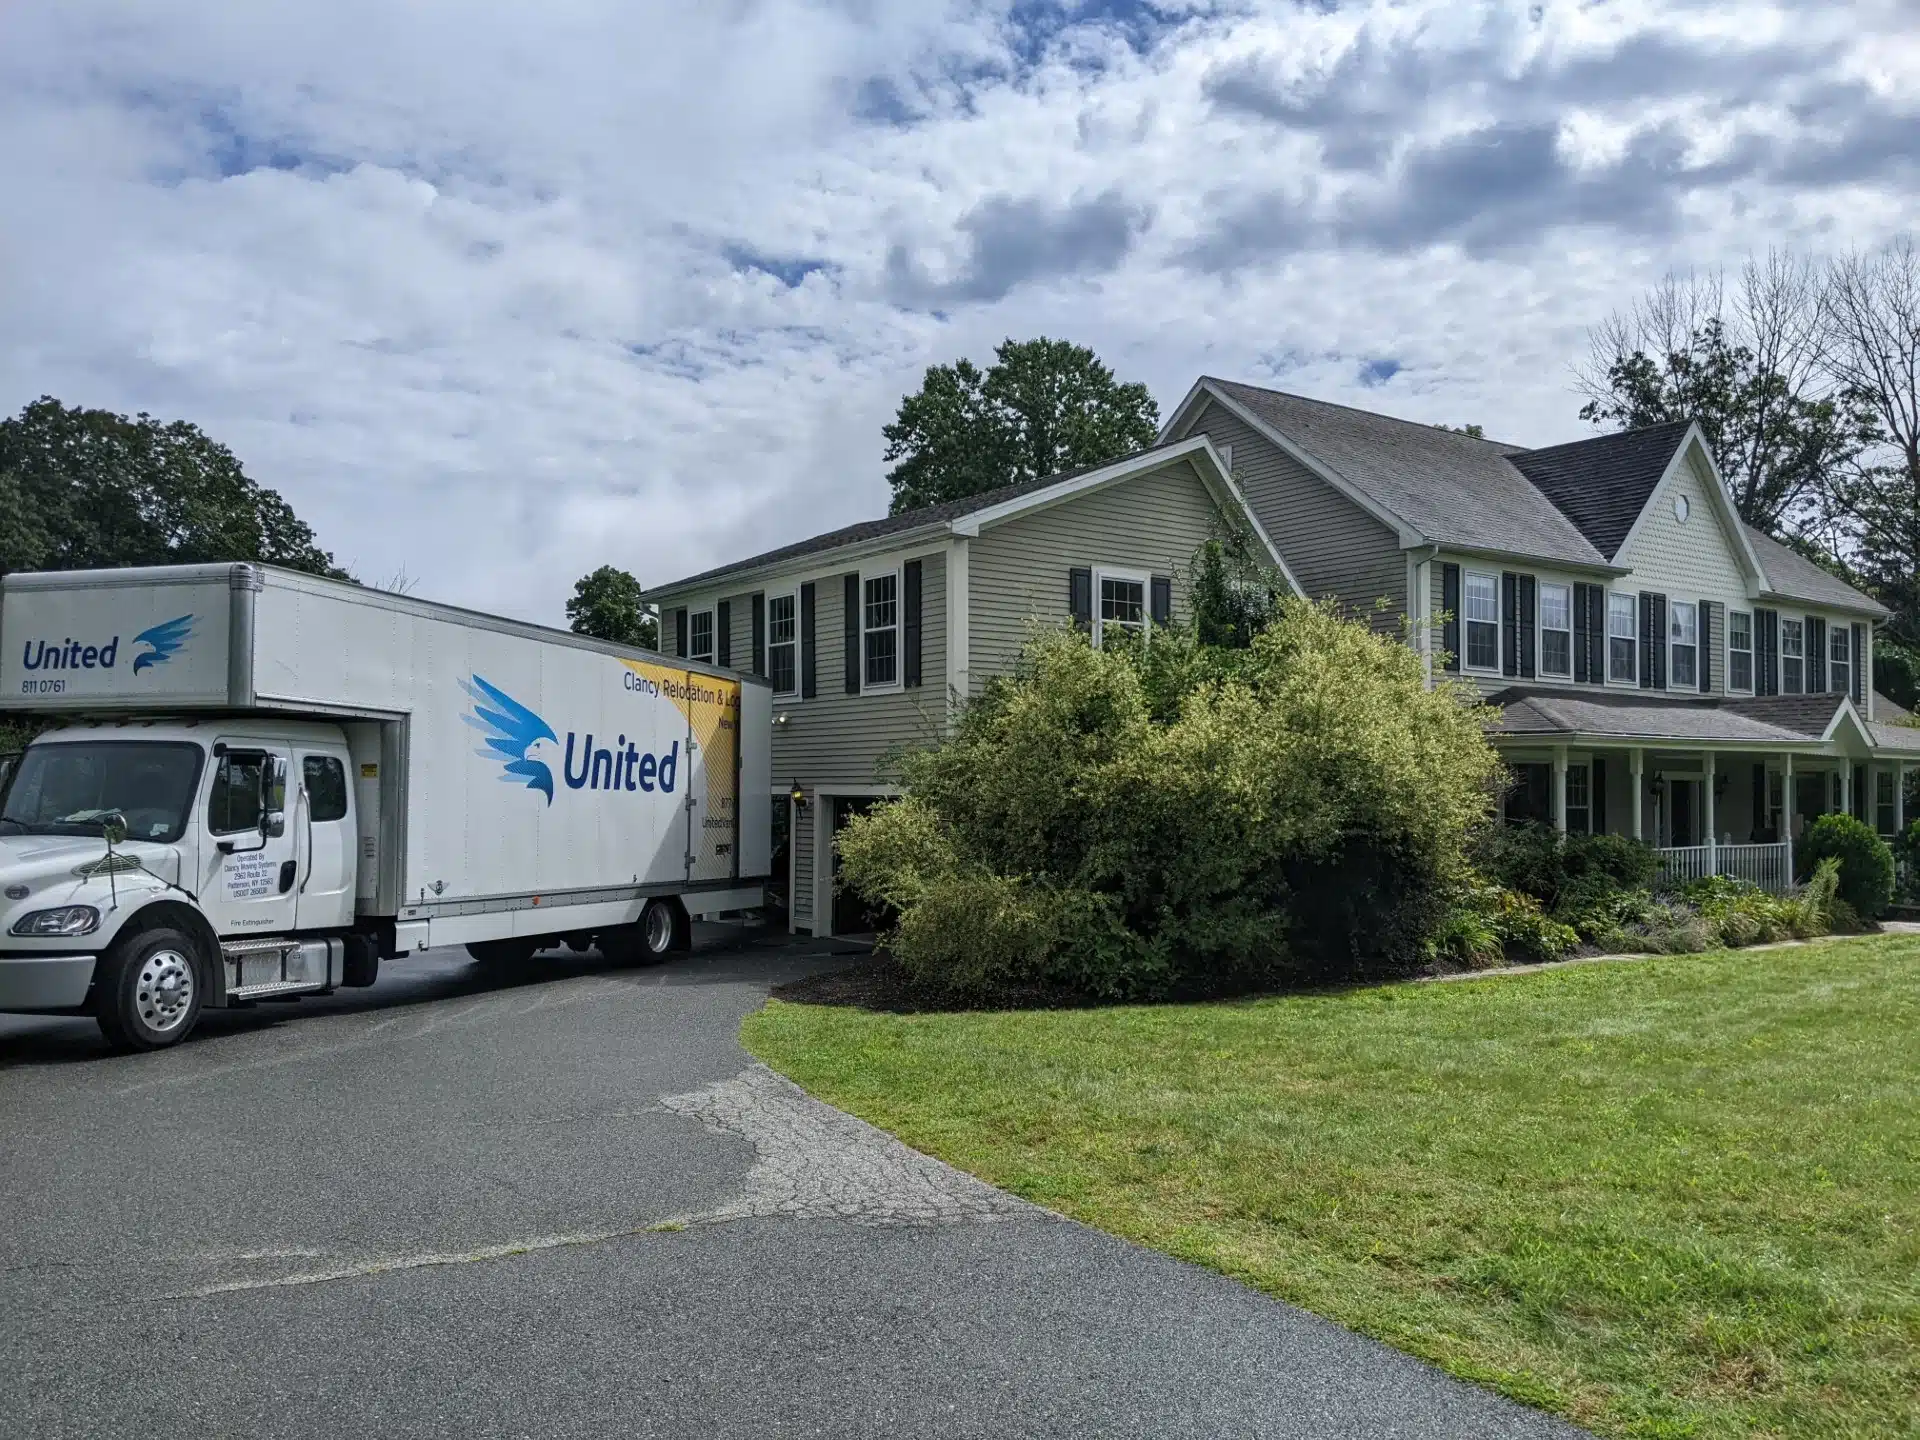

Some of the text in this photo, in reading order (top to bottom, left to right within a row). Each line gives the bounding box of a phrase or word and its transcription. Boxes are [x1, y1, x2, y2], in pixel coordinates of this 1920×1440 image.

[23, 636, 119, 670] United
[22, 680, 65, 693] 811 0761
[624, 671, 660, 698] Clancy
[663, 679, 715, 704] Relocation
[717, 689, 724, 705] &
[564, 732, 679, 793] United
[236, 852, 265, 862] Operated By
[241, 862, 257, 871] Moving
[247, 871, 260, 879] Route
[252, 879, 258, 887] NY
[233, 889, 249, 898] USDOT
[230, 918, 274, 927] Fire Extinguisher
